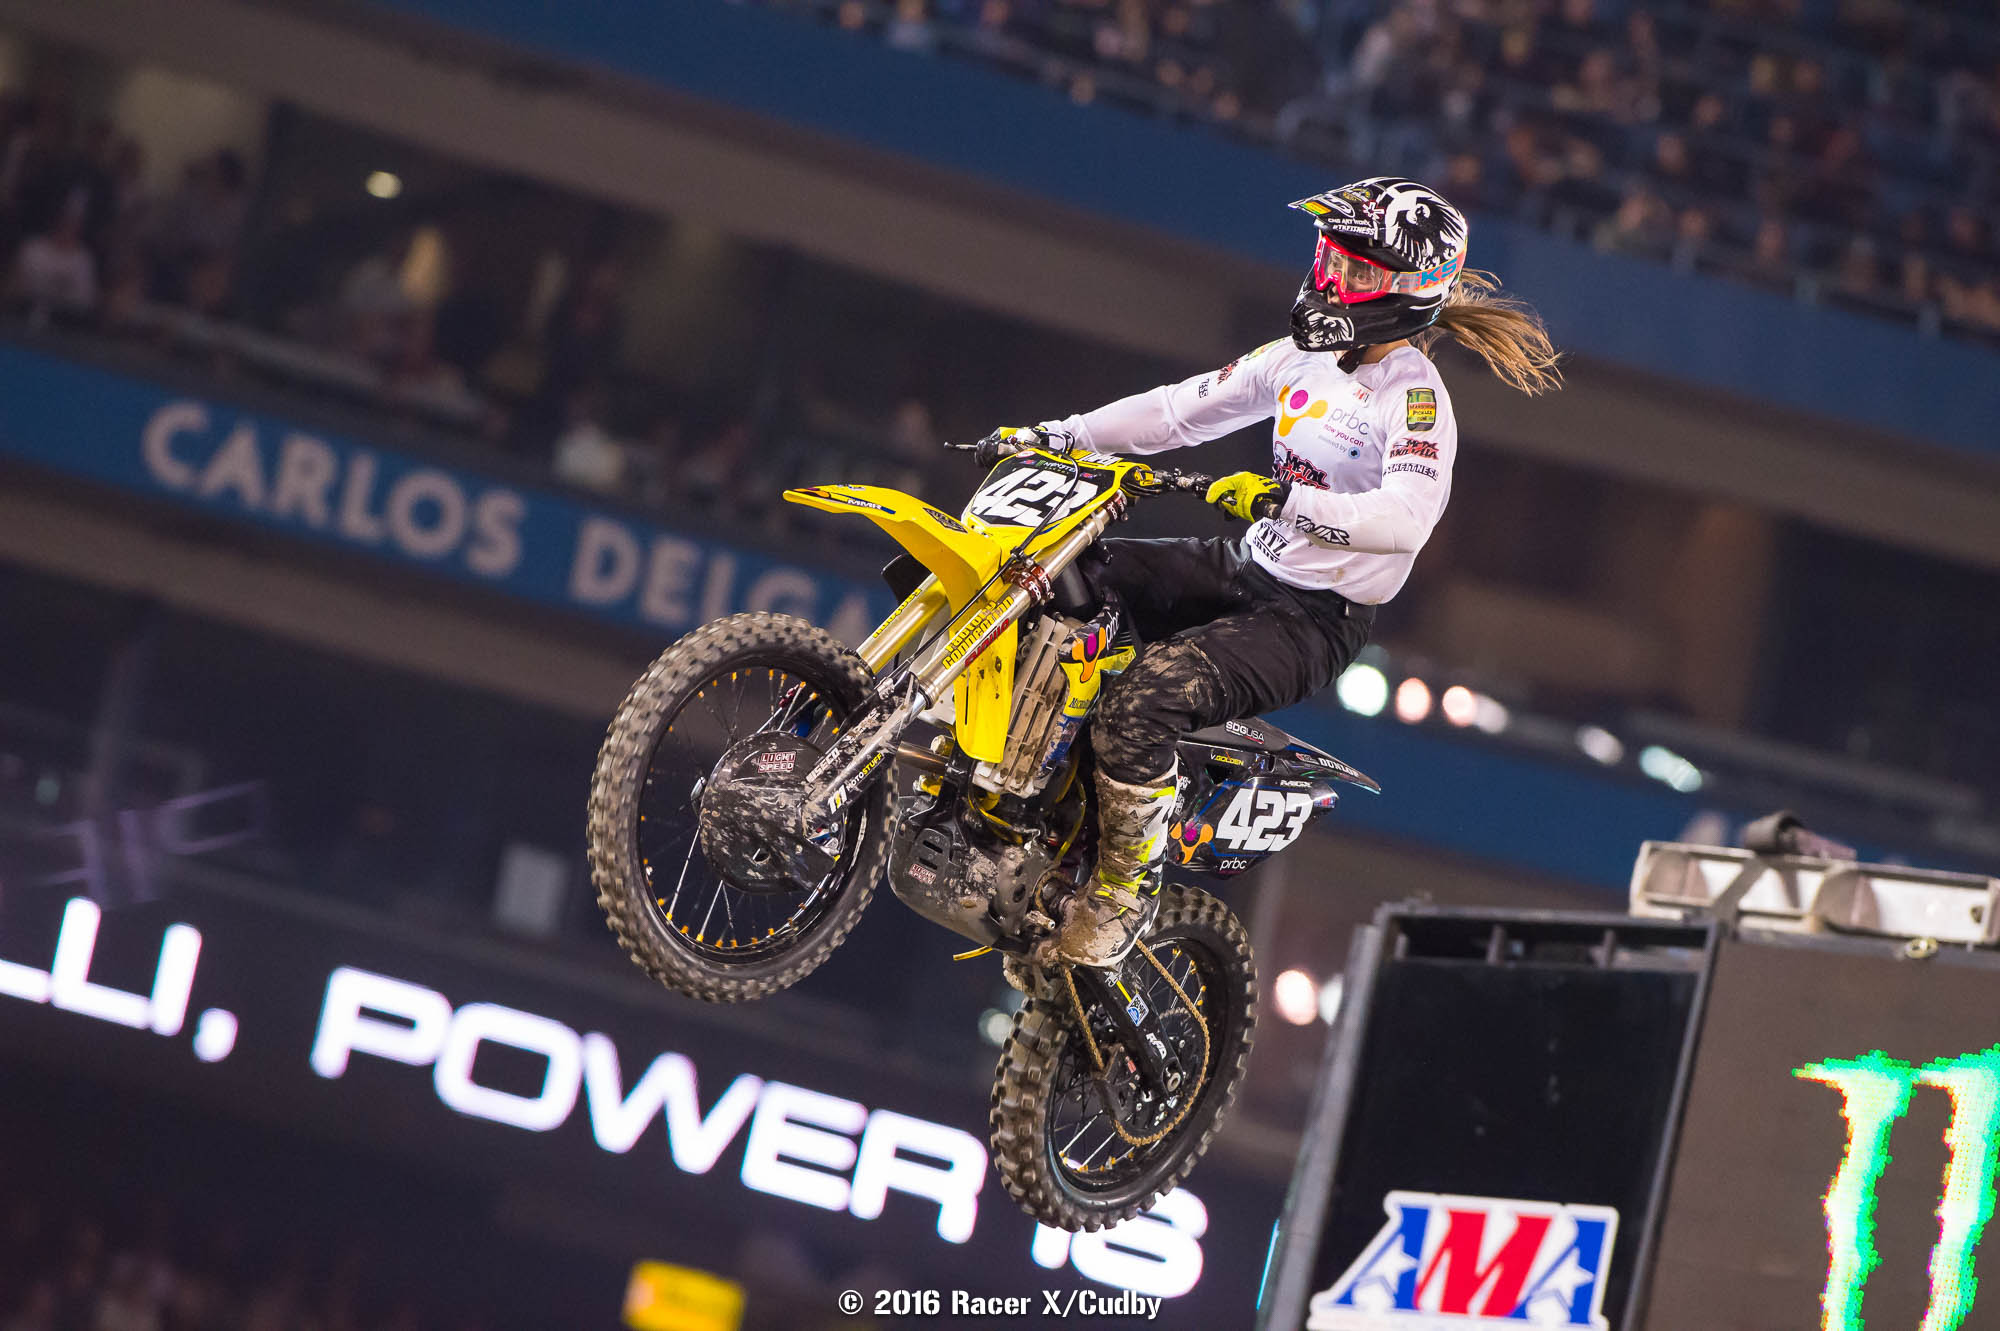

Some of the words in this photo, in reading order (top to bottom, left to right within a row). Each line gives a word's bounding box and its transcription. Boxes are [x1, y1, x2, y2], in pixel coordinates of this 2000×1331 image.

[1328, 408, 1370, 436] prbc
[1335, 431, 1350, 442] you
[1349, 436, 1365, 448] can
[1042, 460, 1078, 474] MONSTE
[142, 402, 526, 577] CARLOS
[971, 467, 1098, 527] 423
[759, 762, 794, 772] SPEED
[761, 753, 796, 763] LIGHT
[1215, 788, 1314, 852] 423
[1219, 857, 1248, 871] prbc
[0, 897, 238, 1062] LI,
[310, 965, 988, 1245] POWER
[1328, 1203, 1608, 1325] AMA
